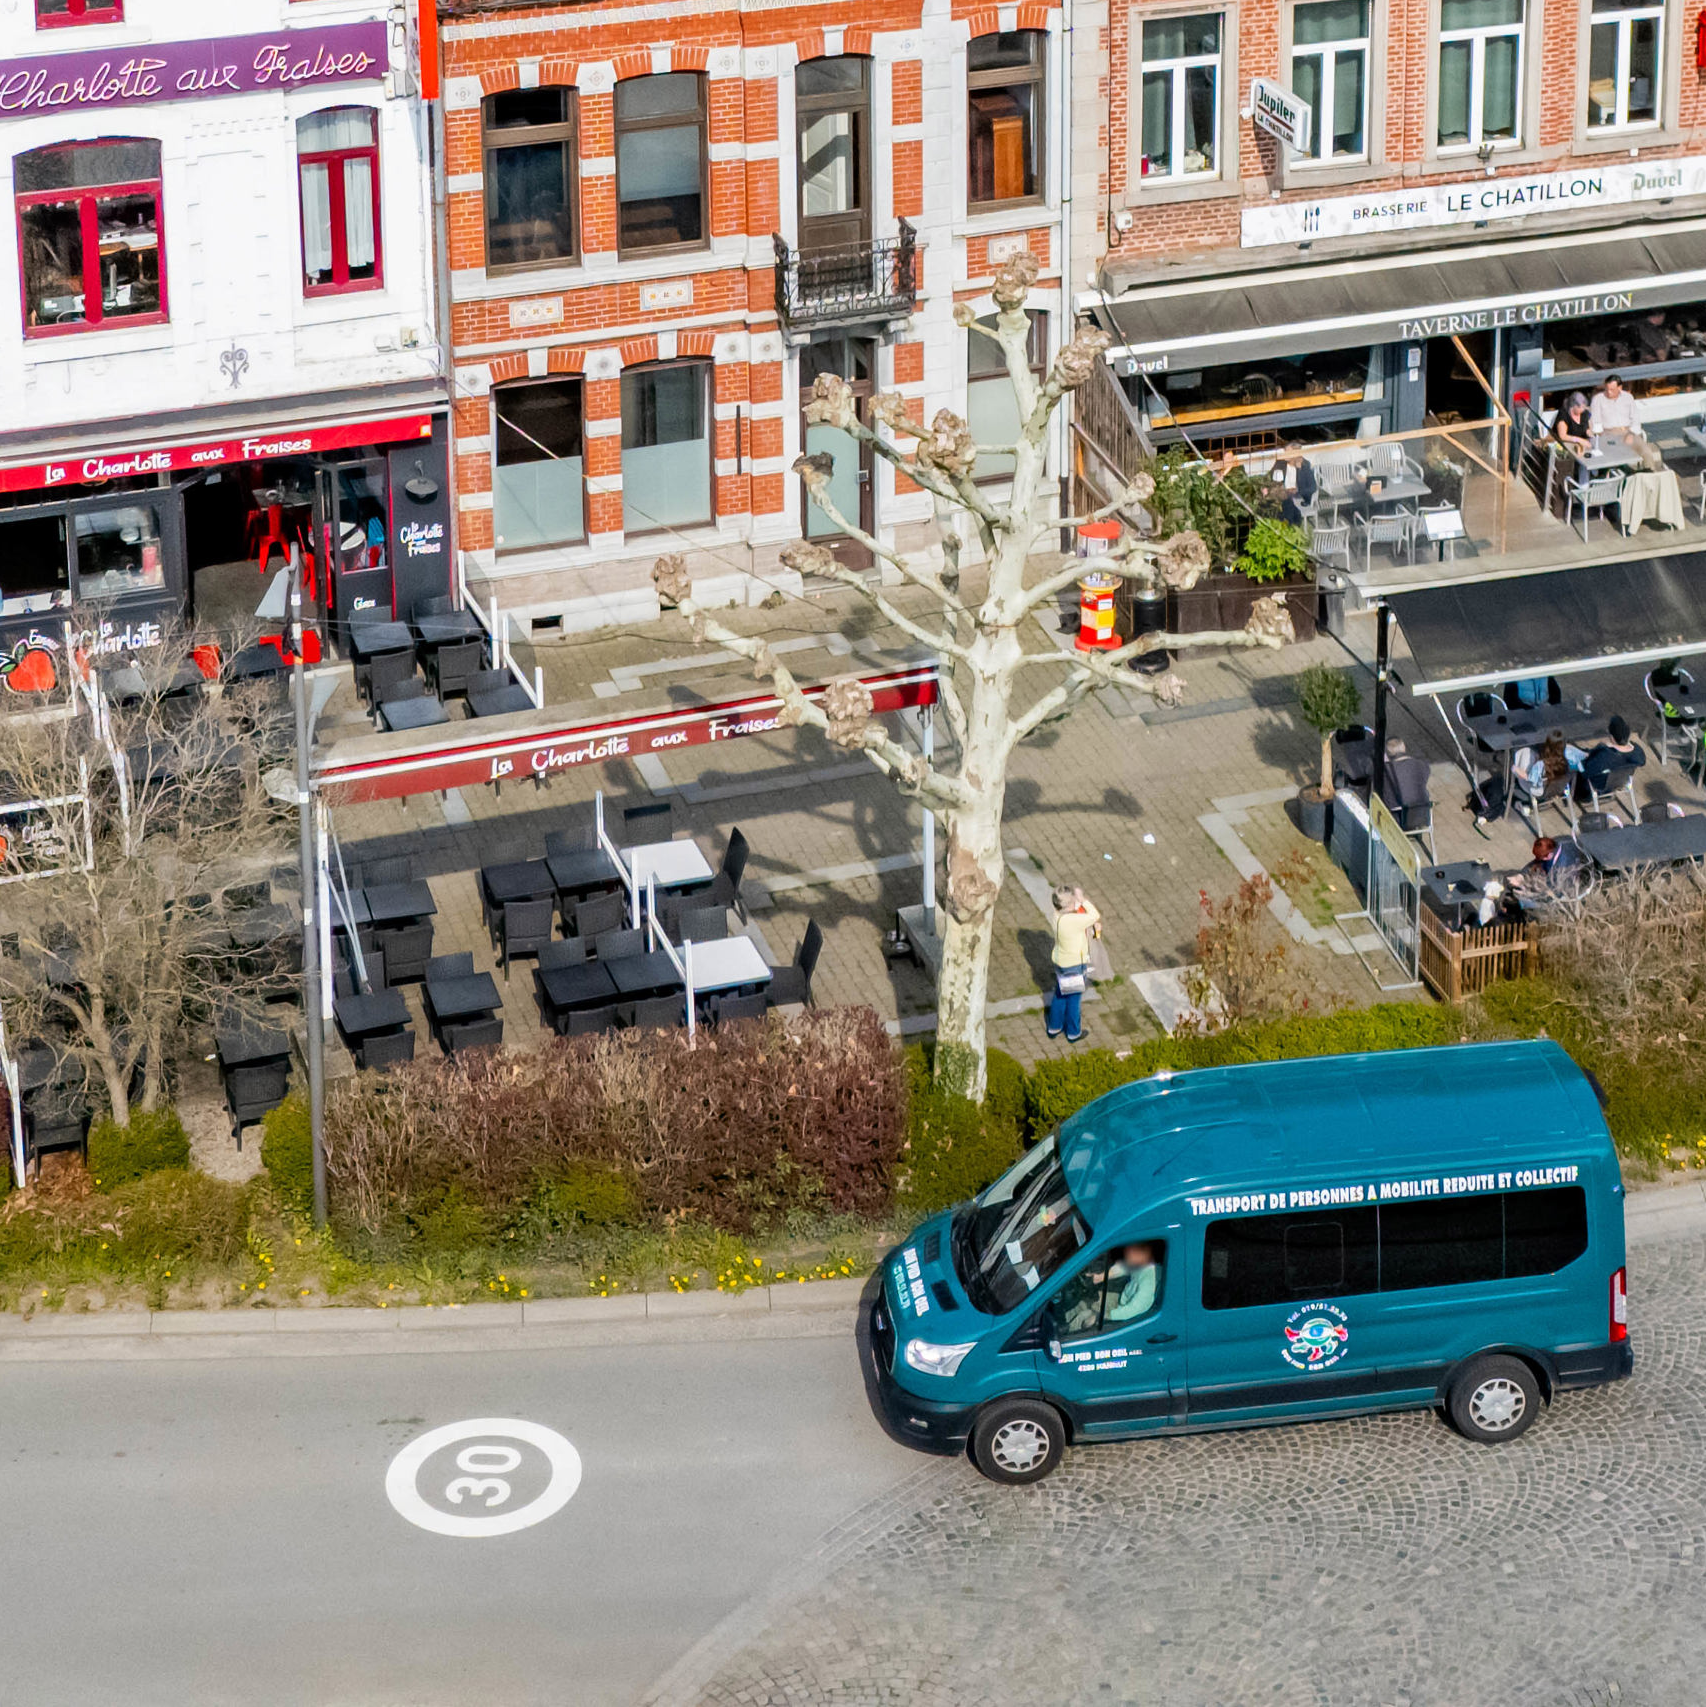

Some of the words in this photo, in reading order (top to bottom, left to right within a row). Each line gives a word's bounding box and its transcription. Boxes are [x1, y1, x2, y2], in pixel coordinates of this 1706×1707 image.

[176, 65, 241, 91] aux
[253, 43, 376, 85] Fraises
[1258, 83, 1296, 124] Jupiler
[1353, 200, 1428, 220] BRASSERIE
[1447, 194, 1473, 213] LE
[1481, 178, 1604, 209] CHATILLON
[1633, 168, 1683, 192] Duvel
[1398, 312, 1488, 339] TAVERNE
[1493, 308, 1517, 327] LE
[1522, 293, 1633, 322] CHATILLON
[45, 465, 66, 485] La
[82, 452, 173, 480] Charlotte
[190, 447, 225, 463] aux
[242, 438, 313, 460] Fraises
[491, 757, 514, 779] La
[531, 736, 629, 772] Charlotte
[651, 729, 689, 748] aux
[1190, 1194, 1266, 1216] TRANSPORT
[1269, 1192, 1286, 1209] DE
[1289, 1185, 1365, 1208] PERSONNES
[1367, 1184, 1378, 1201] A
[1380, 1178, 1440, 1199] MOBILITE
[1443, 1173, 1494, 1194] REDUITE
[1498, 1172, 1512, 1189] ET
[1515, 1165, 1579, 1187] COLLECTIF
[445, 1445, 522, 1507] 30
